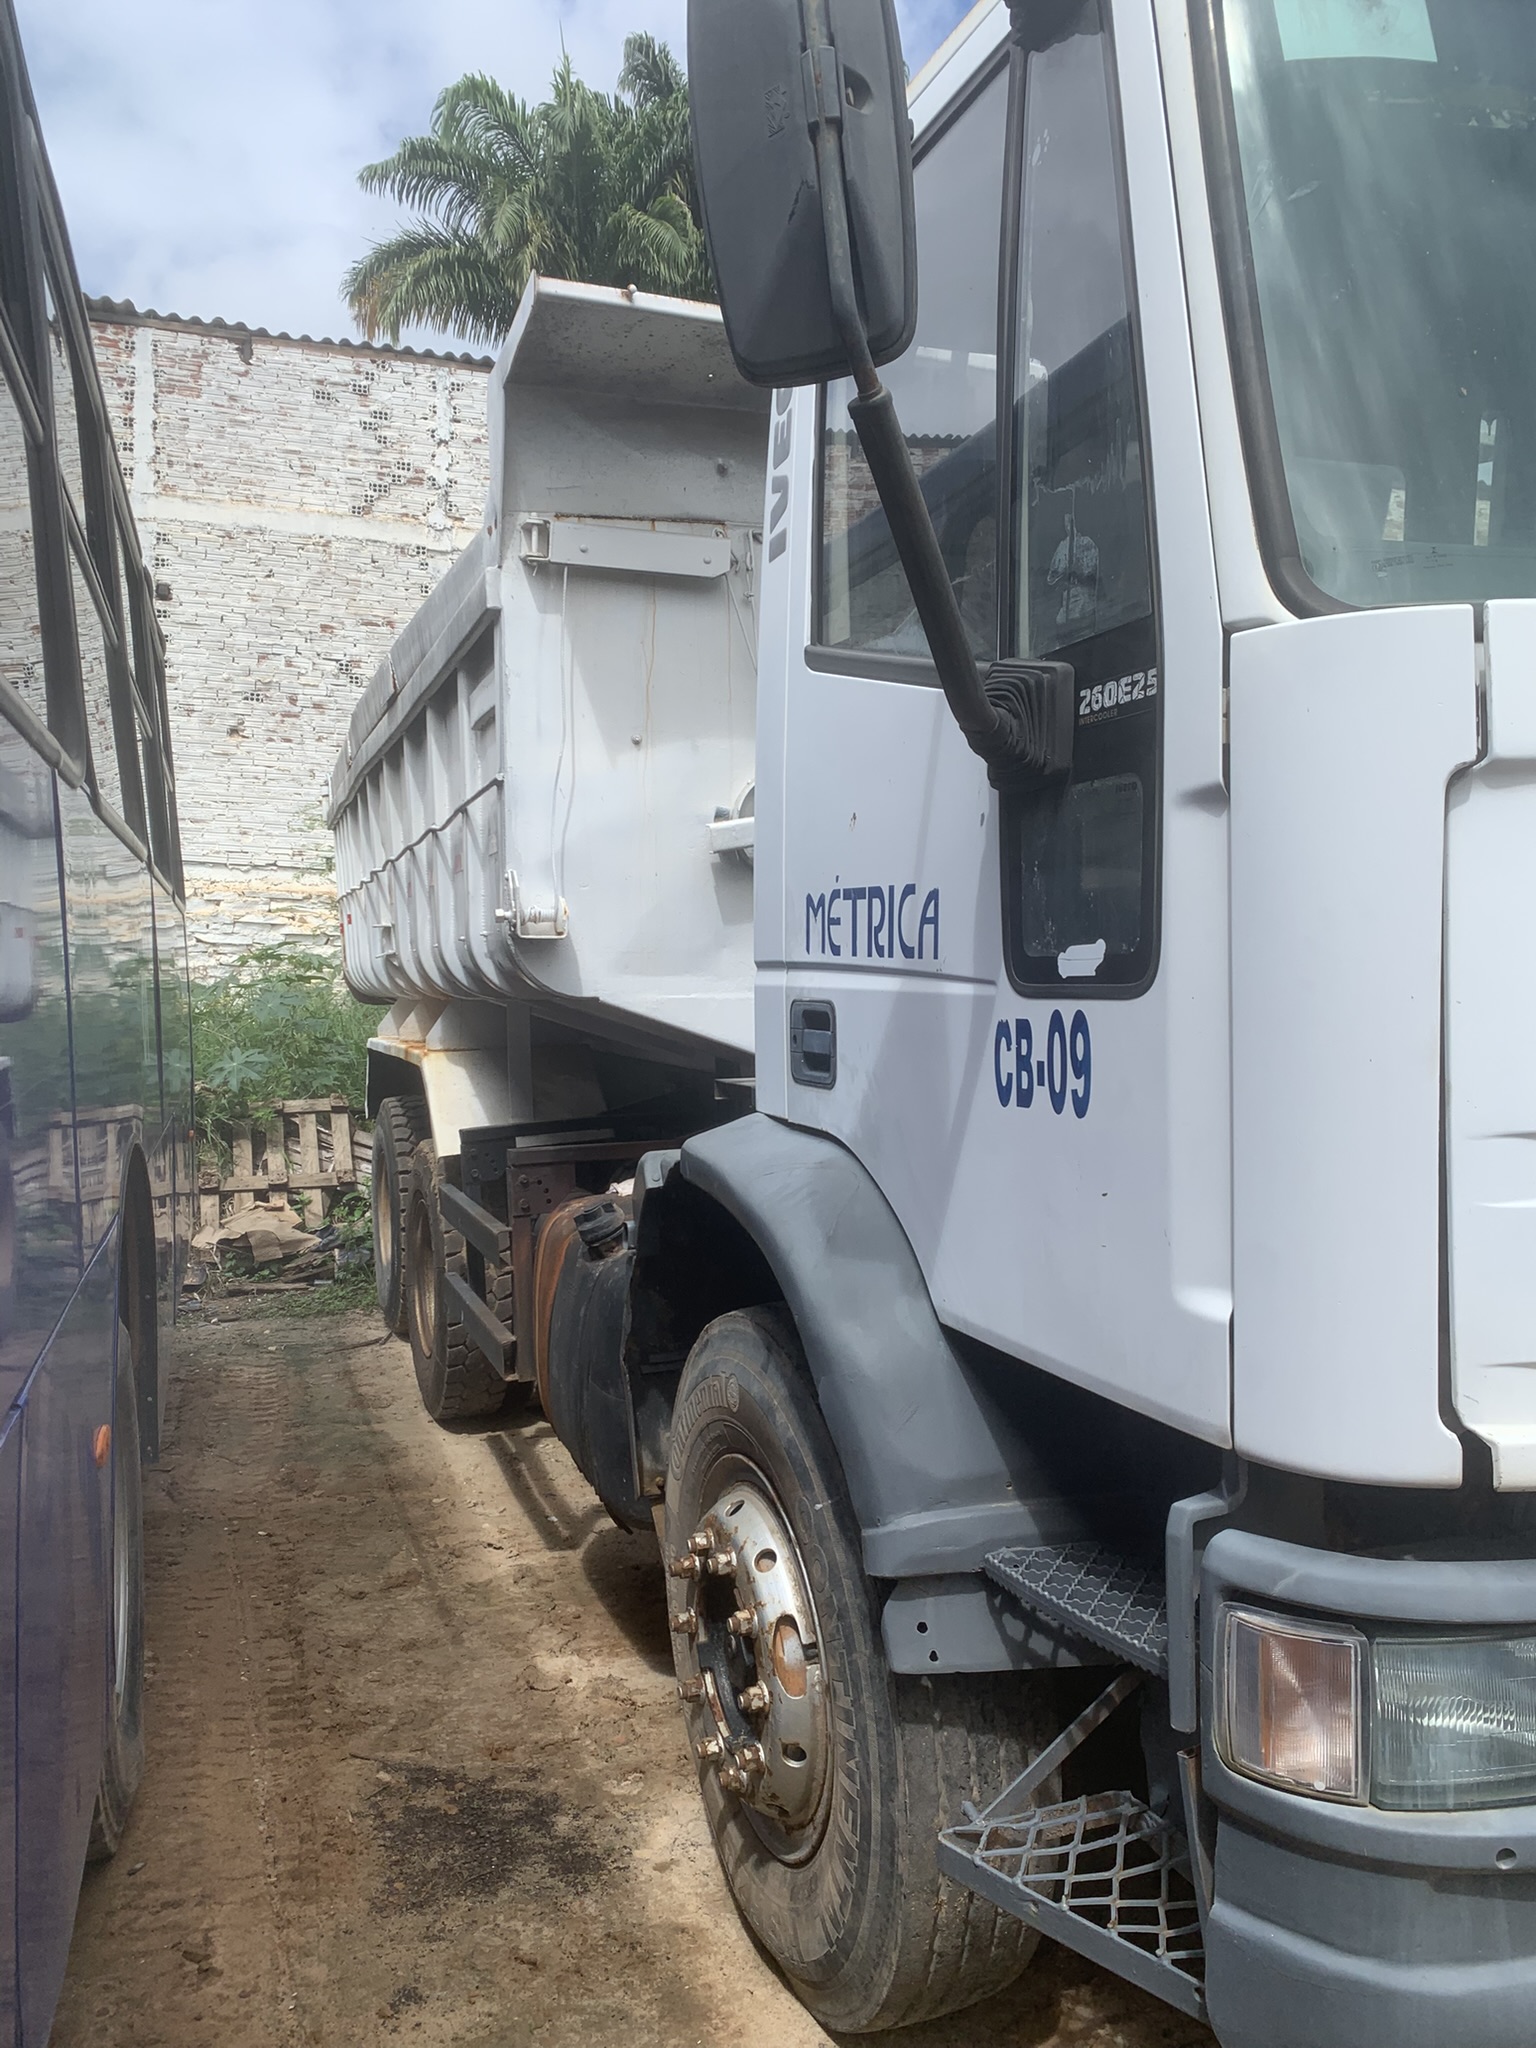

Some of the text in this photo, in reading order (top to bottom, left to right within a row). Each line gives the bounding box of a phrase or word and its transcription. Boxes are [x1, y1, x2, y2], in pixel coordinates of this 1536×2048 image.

[1079, 667, 1157, 715] 260E25
[1079, 708, 1118, 725] INTERCOOLER
[805, 875, 940, 960] MÉTRICA
[994, 1009, 1092, 1119] CB-09
